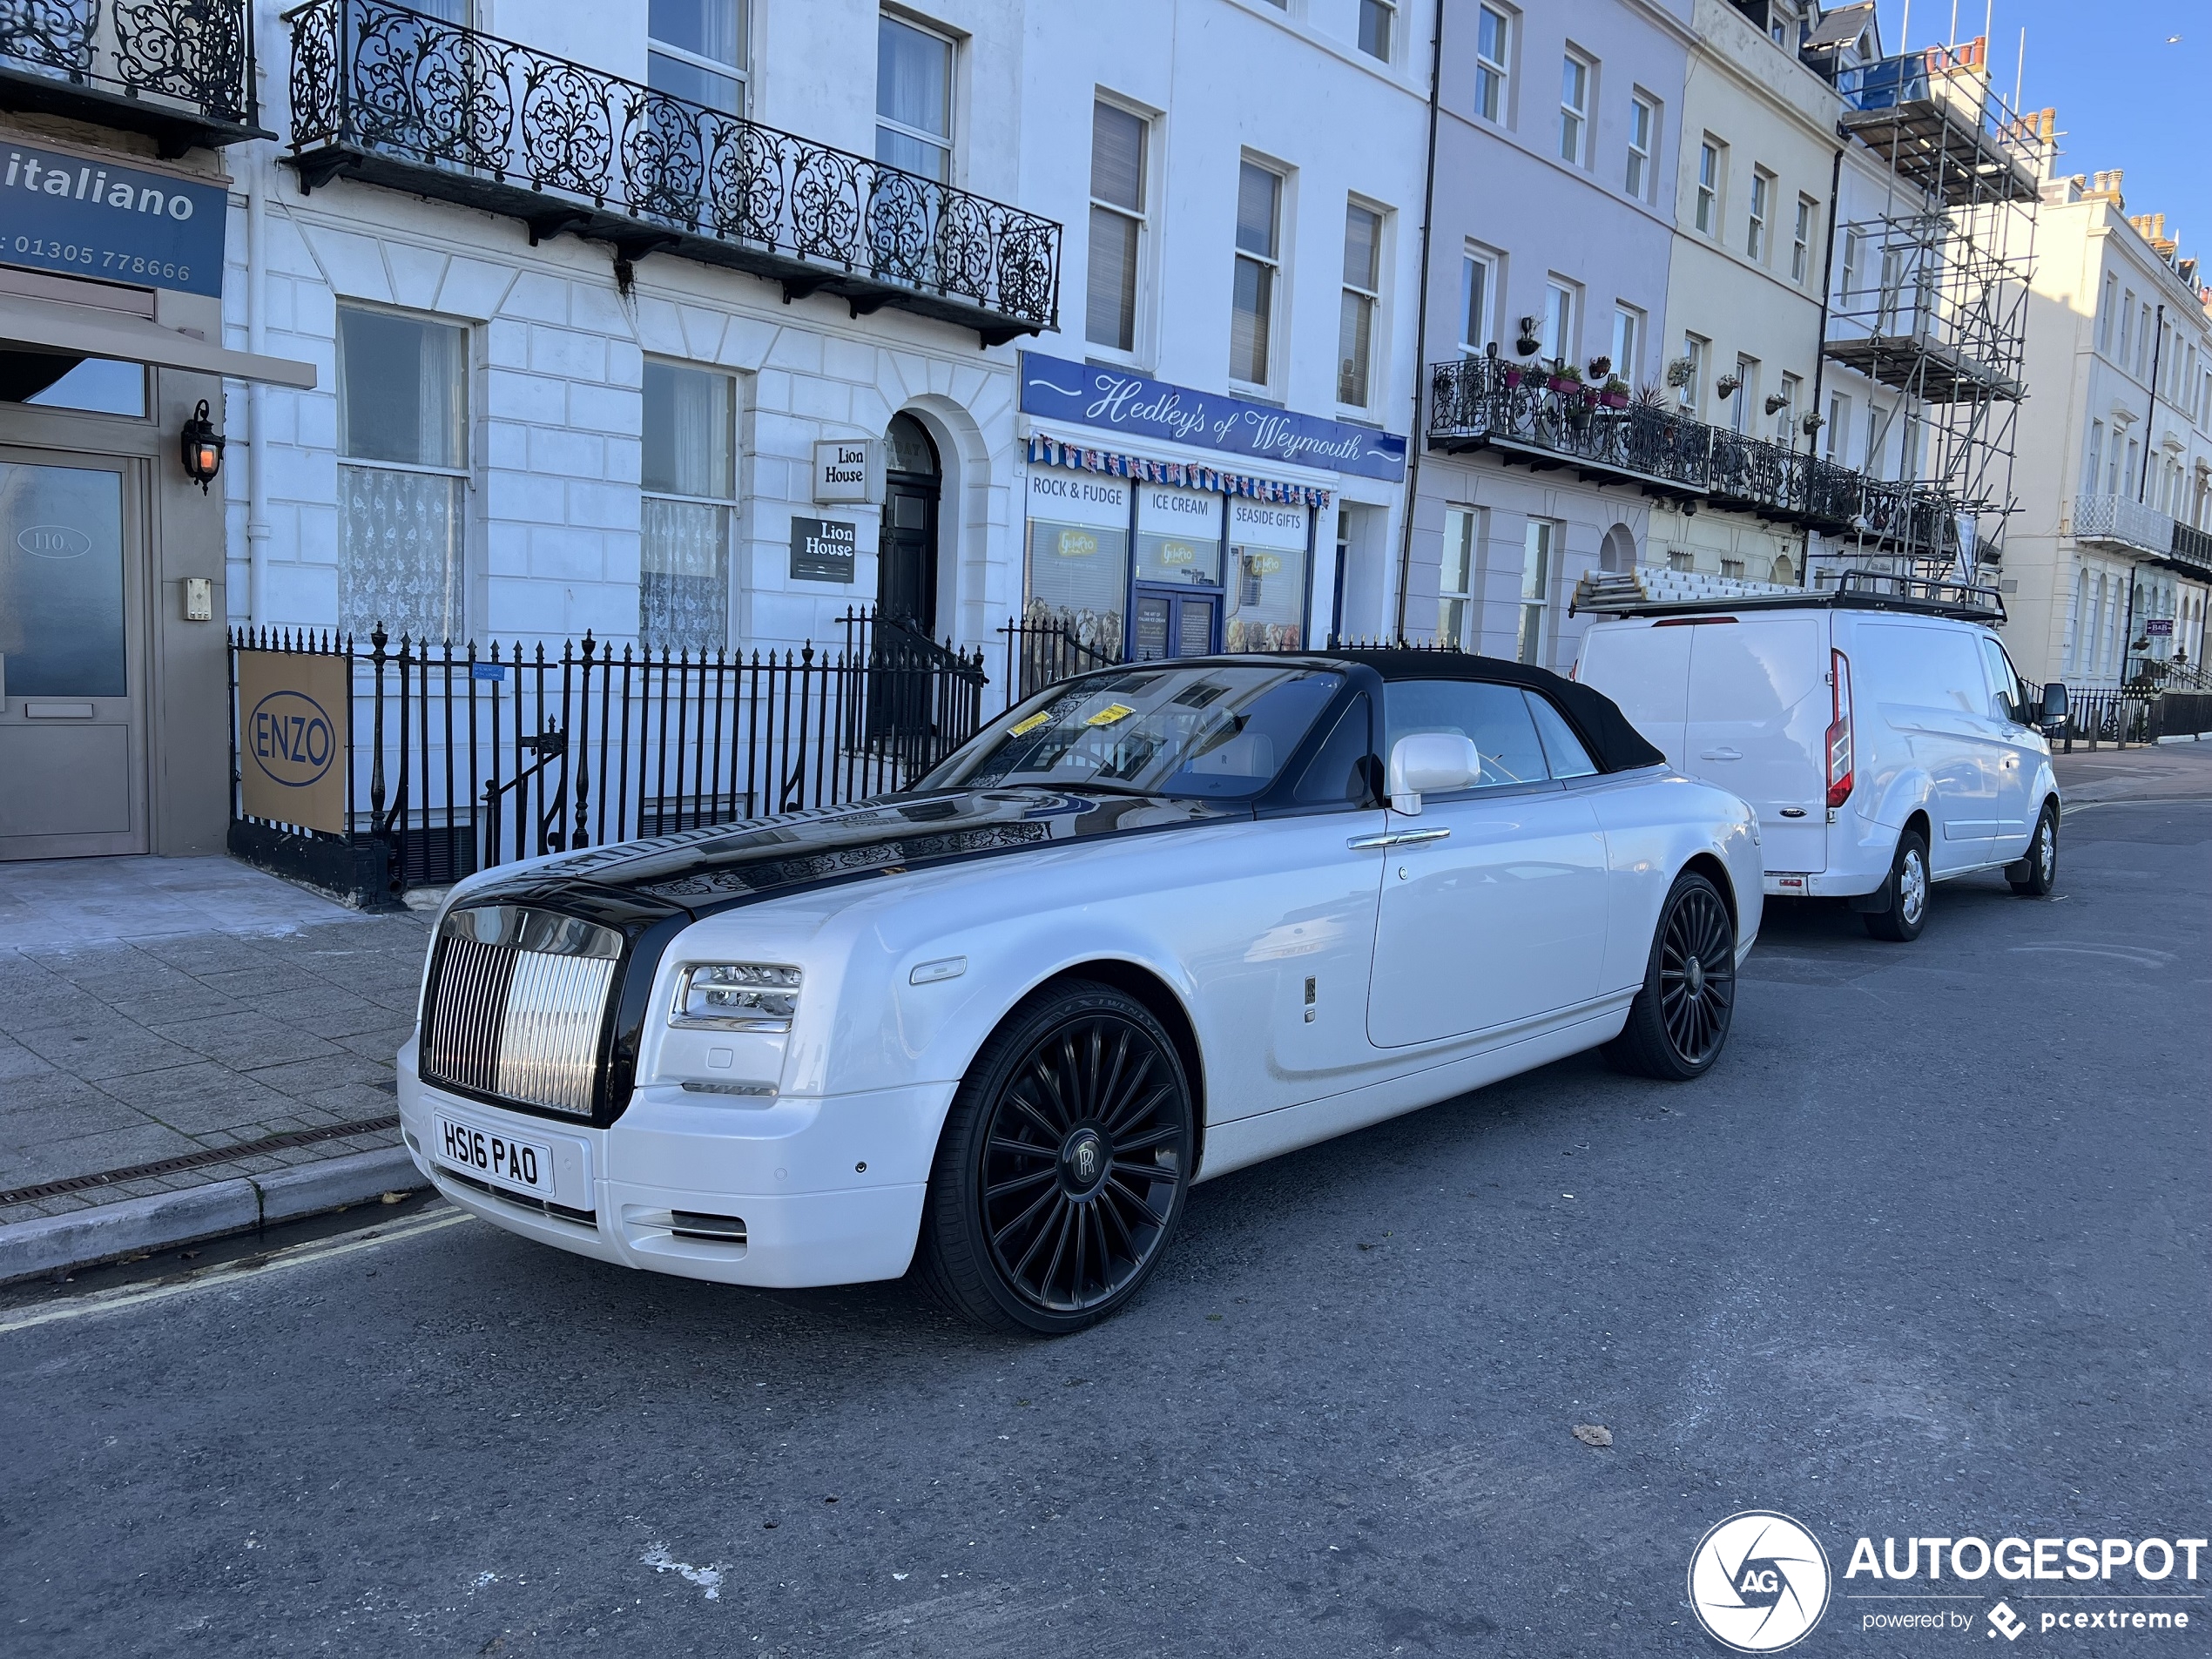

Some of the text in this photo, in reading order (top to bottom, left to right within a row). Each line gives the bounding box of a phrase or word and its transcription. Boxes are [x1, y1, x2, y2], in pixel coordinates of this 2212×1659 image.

[5, 152, 193, 220] italiano
[15, 236, 94, 264] 01305
[103, 251, 190, 281] 778666
[1086, 374, 1361, 461] Hedley's of Weymouth
[838, 448, 864, 464] Lion
[825, 467, 864, 482] House
[1034, 477, 1123, 505] ROCK & FUDGE
[1152, 493, 1209, 516] ICE CREAM
[1236, 507, 1301, 529] SEASIDE GIFTS
[821, 523, 853, 542] Lion
[806, 536, 853, 557] House
[256, 712, 330, 766] ENZO
[443, 1121, 537, 1185] HS16 PAO
